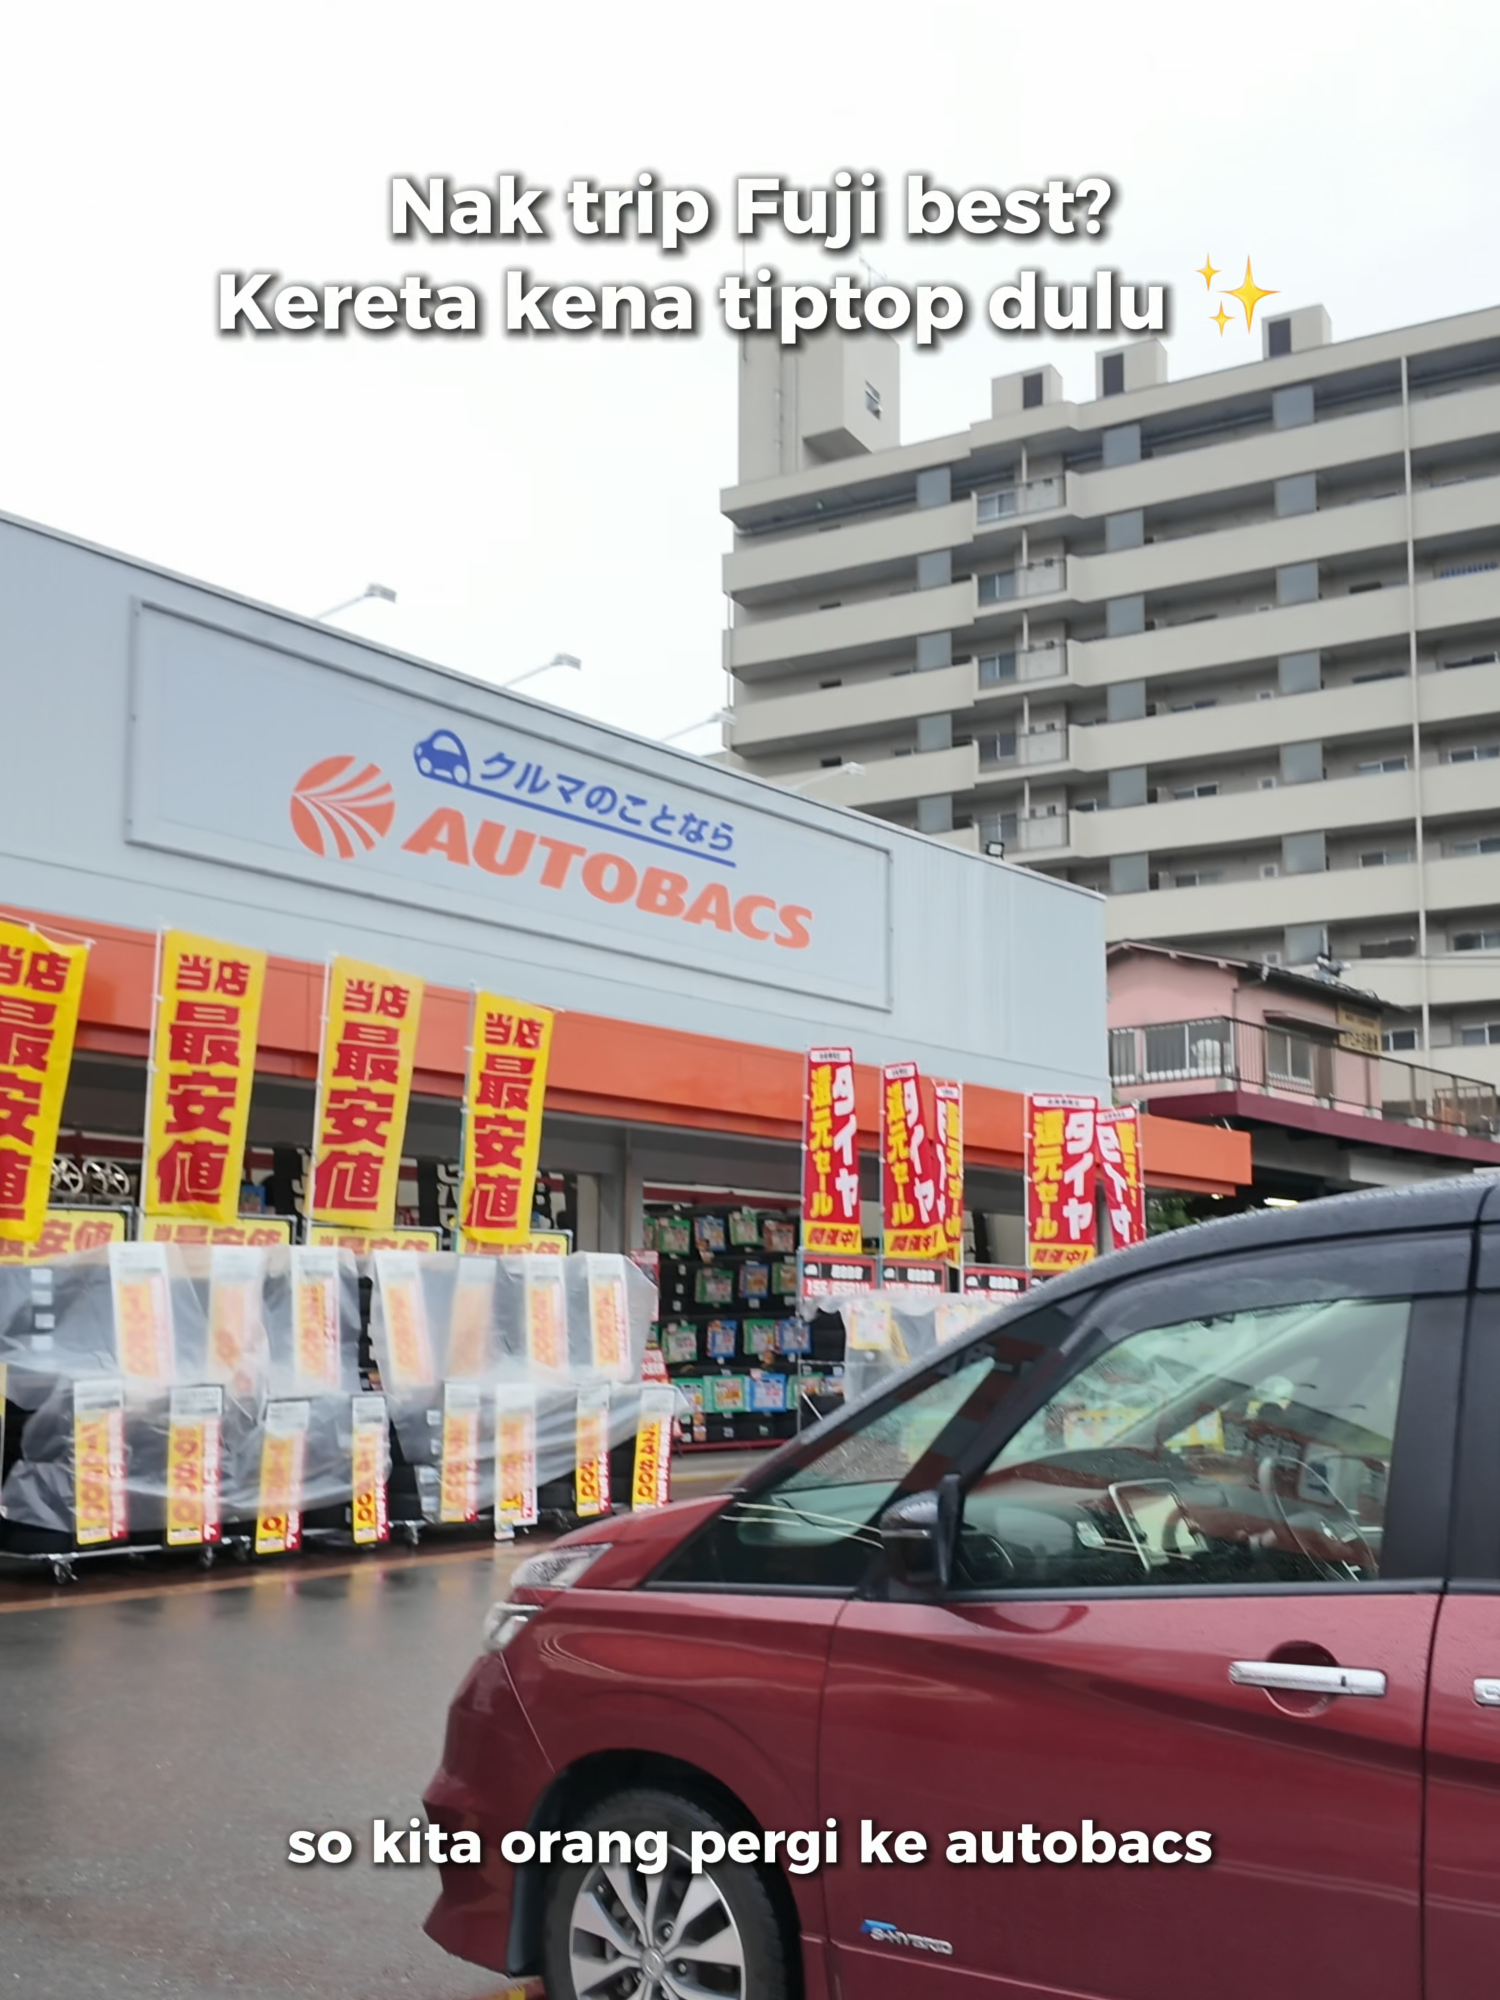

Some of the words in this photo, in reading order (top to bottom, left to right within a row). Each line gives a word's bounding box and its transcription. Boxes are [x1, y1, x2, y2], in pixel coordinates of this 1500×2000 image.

[479, 751, 735, 853] クルマのことなら
[401, 807, 812, 949] AUTOBACS
[176, 954, 250, 997] 当店
[343, 979, 409, 1020] 当店
[485, 1012, 544, 1049] 当店
[156, 1001, 240, 1204] 最安値
[315, 1021, 400, 1211] 最安値
[463, 1053, 536, 1230] 最安値
[832, 1064, 859, 1218] タイヤ
[903, 1078, 935, 1224] タイヤ
[1062, 1110, 1095, 1241] タイヤ
